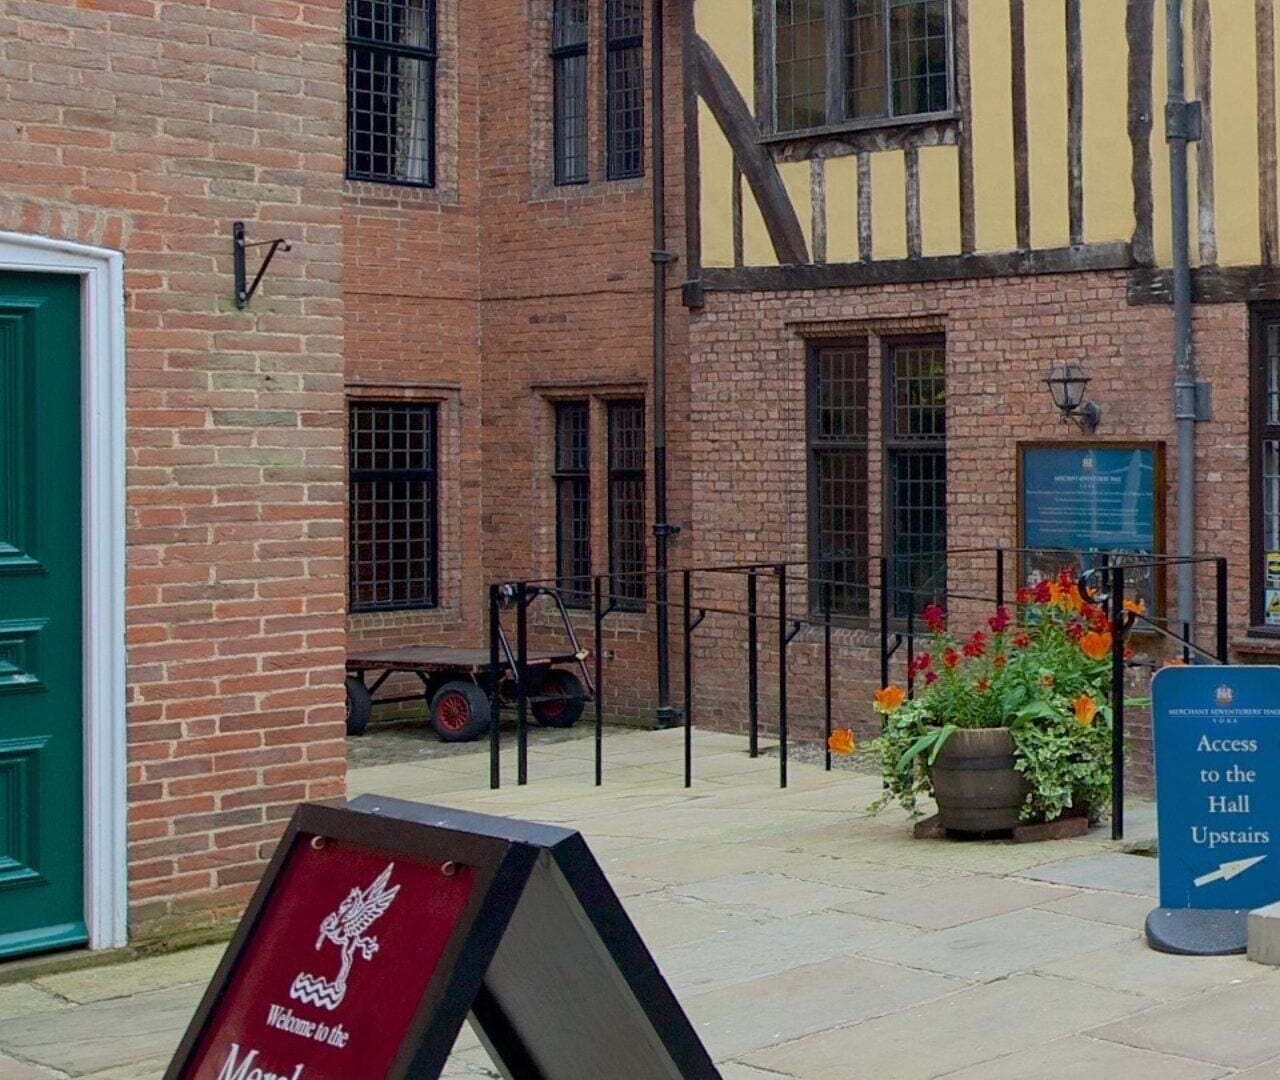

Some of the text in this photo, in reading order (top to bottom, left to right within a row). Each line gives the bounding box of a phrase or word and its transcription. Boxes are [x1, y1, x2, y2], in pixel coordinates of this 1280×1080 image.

[1196, 734, 1258, 752] Access
[1200, 764, 1256, 782] to the
[1208, 795, 1250, 813] Hall
[1190, 826, 1270, 849] Upstairs
[266, 1004, 350, 1048] Welcome to the
